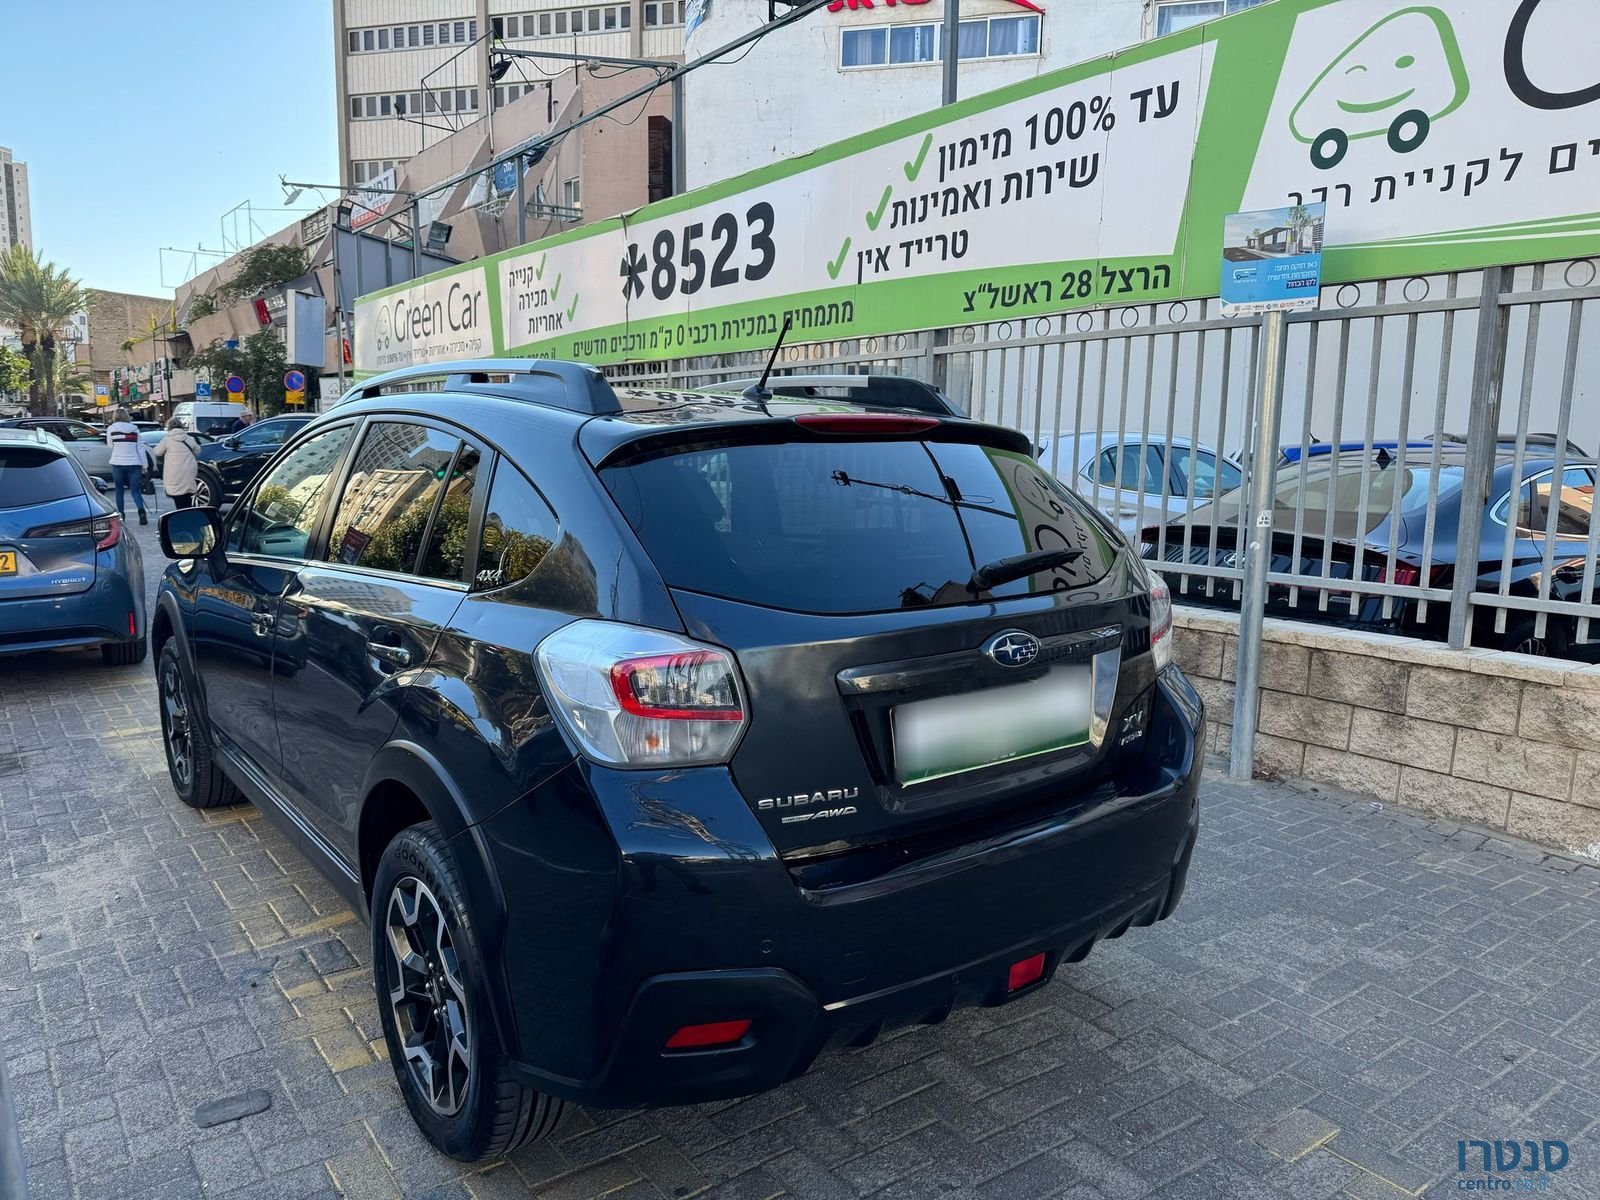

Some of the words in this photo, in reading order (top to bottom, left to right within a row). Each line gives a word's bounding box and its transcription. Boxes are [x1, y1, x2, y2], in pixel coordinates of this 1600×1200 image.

[1130, 80, 1180, 123] עד
[1025, 95, 1116, 151] 100%
[938, 127, 1012, 183] מימון
[1000, 152, 1100, 205] שירות
[1370, 147, 1523, 204] לקניית
[890, 178, 991, 229] ואמינות
[899, 229, 969, 268] טרייד
[509, 266, 533, 288] קנייה
[857, 246, 891, 285] אין
[1102, 264, 1171, 295] הרצל
[519, 289, 547, 311] מכירה
[963, 279, 1052, 312] ראשל"צ
[1060, 270, 1092, 301] 28
[394, 299, 443, 343] Green
[448, 282, 481, 331] Car
[528, 312, 563, 335] אחריות
[783, 300, 853, 330] מתמחים
[611, 333, 646, 353] ורכבים
[677, 324, 684, 346] 0
[688, 321, 717, 344] רכבי
[721, 314, 777, 342] במכירת
[573, 339, 607, 357] חדשים
[0, 554, 10, 570] 2
[758, 787, 859, 810] SUBARU
[811, 806, 858, 820] AWD
